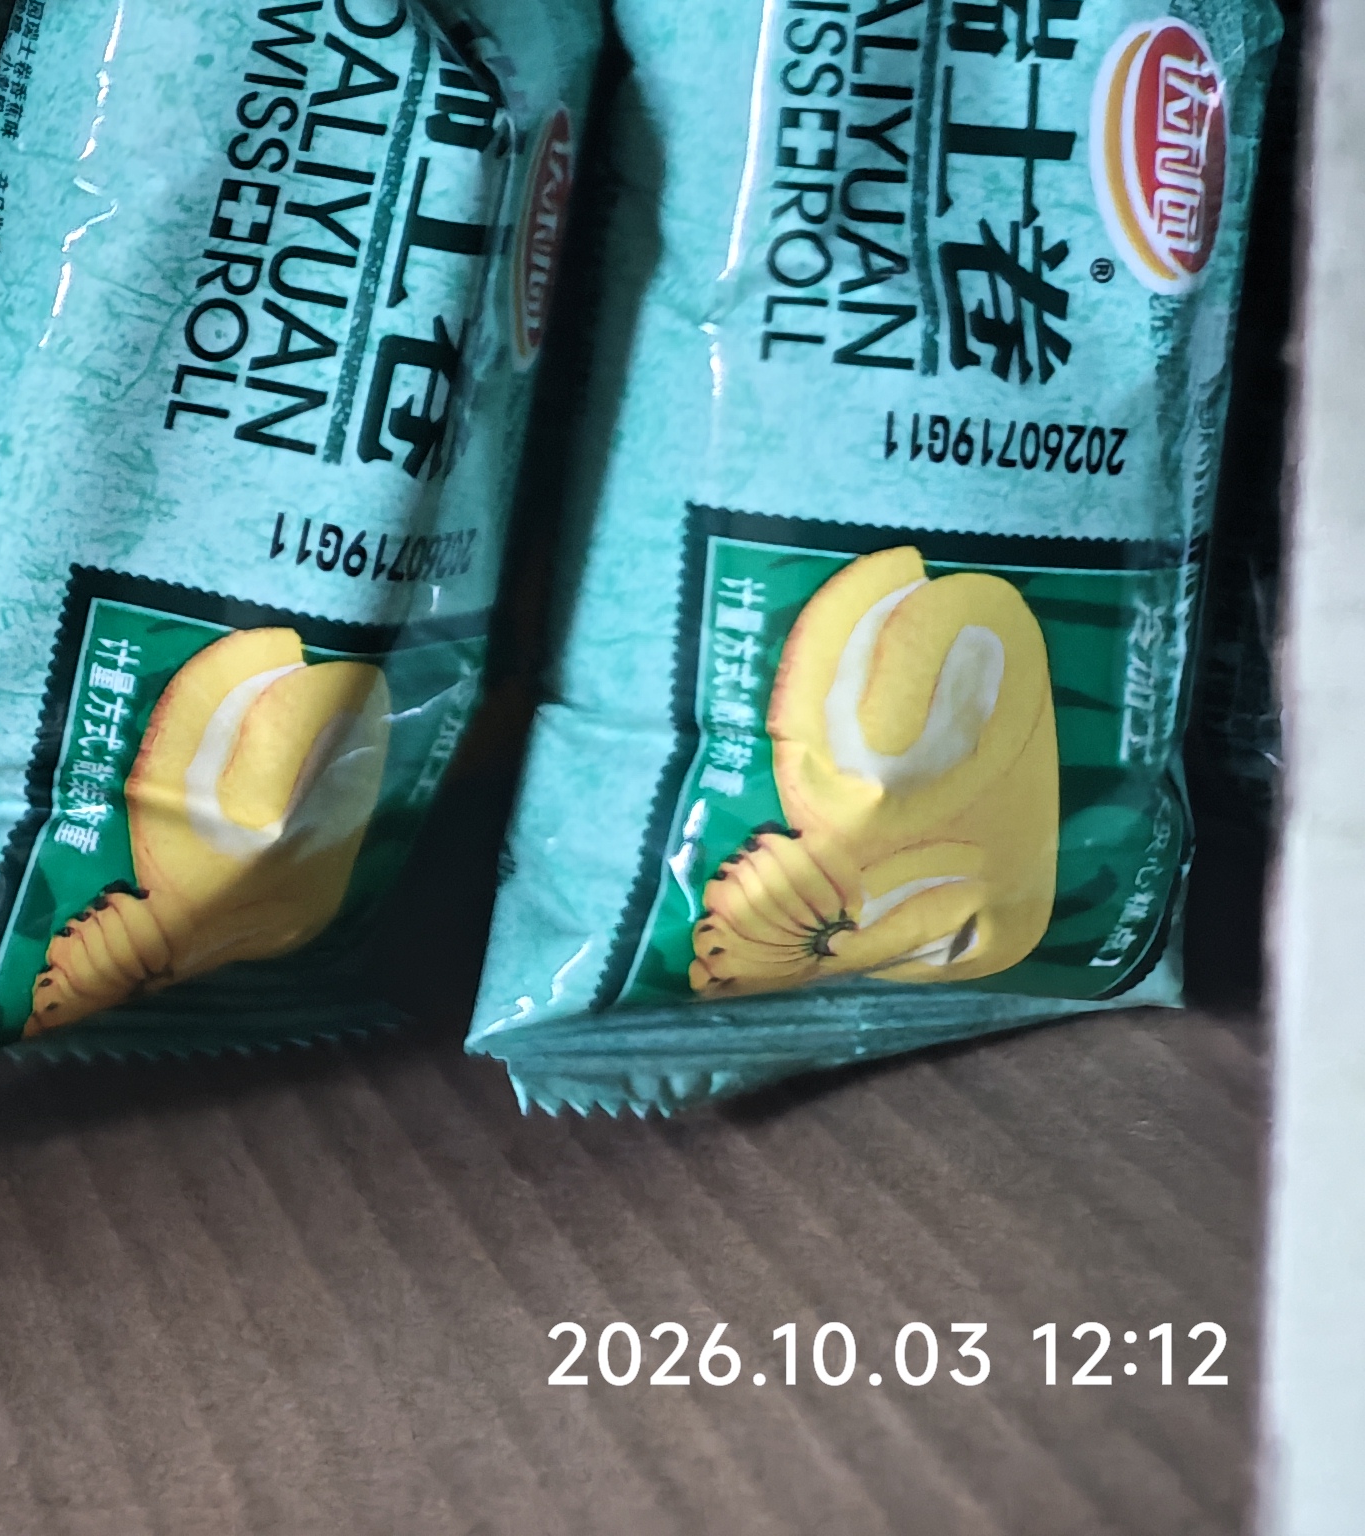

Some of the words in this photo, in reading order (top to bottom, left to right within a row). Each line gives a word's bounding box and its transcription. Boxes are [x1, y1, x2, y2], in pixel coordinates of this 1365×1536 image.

[1150, 52, 1210, 254] 达利园
[164, 251, 263, 430] ROLL
[760, 183, 834, 360] ROLL
[880, 411, 1127, 475] 20260719G11
